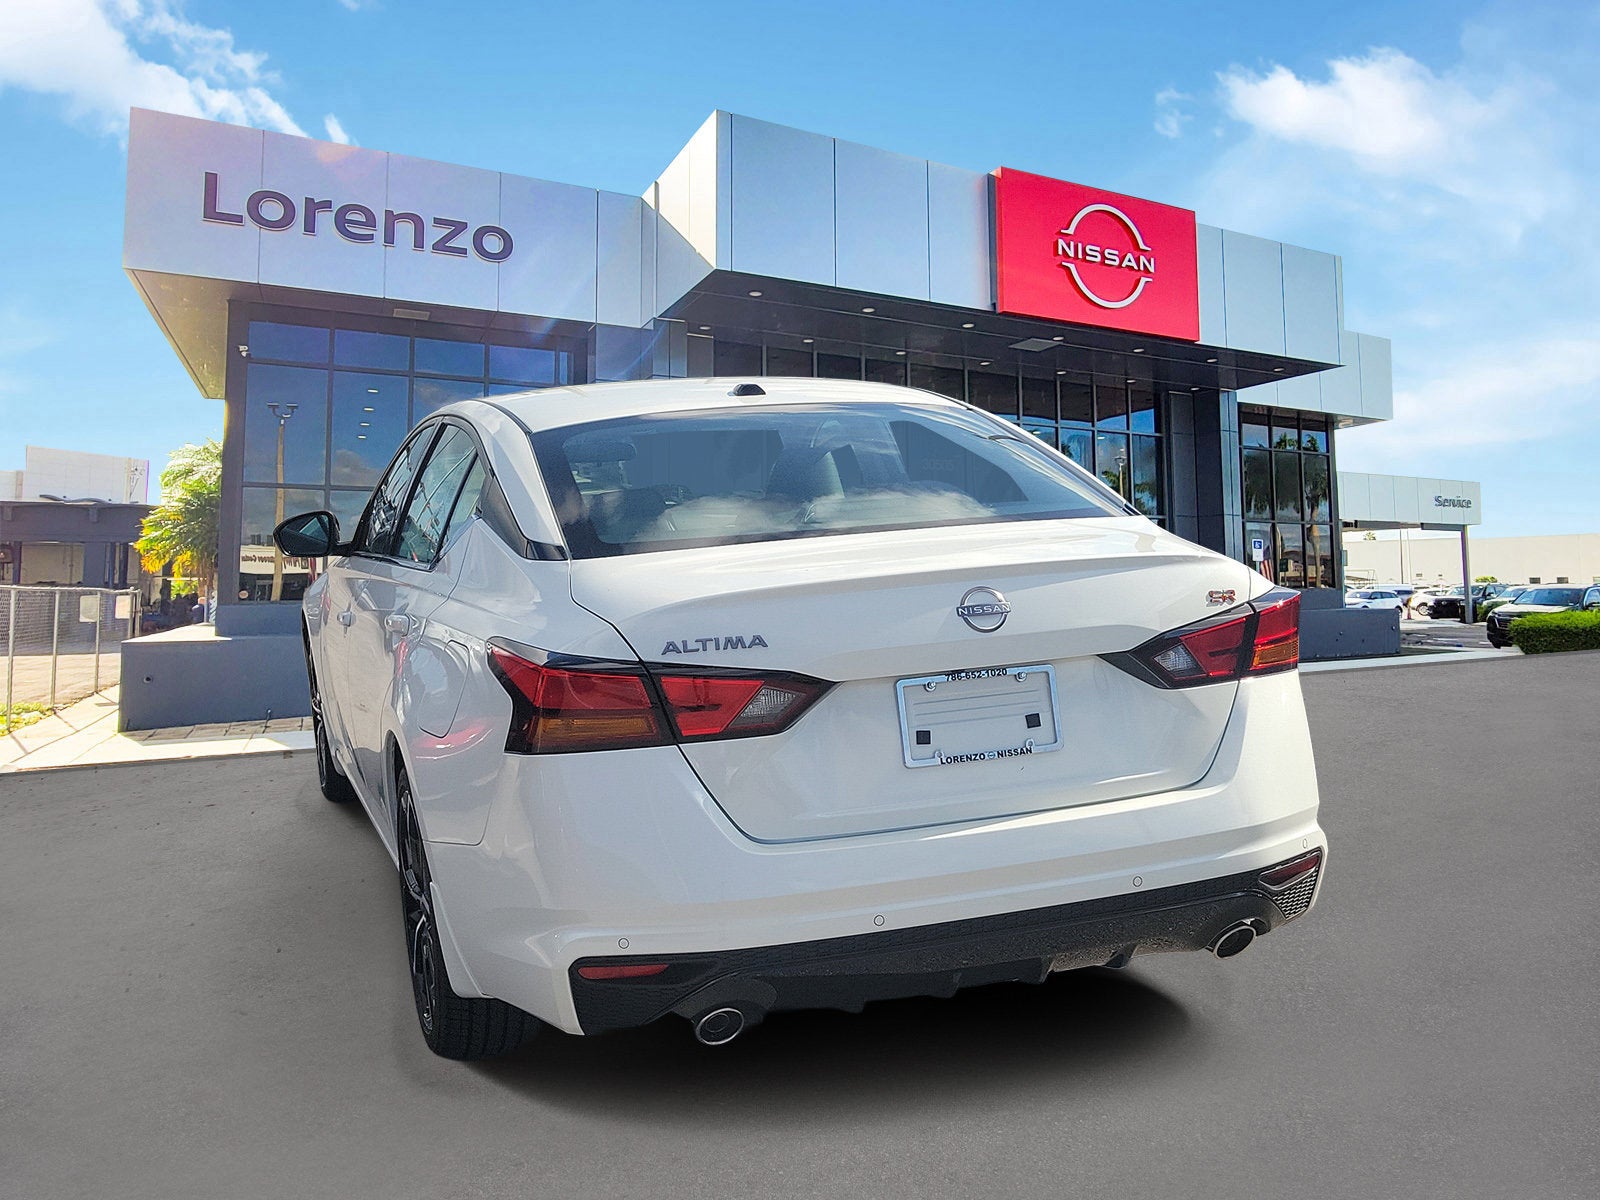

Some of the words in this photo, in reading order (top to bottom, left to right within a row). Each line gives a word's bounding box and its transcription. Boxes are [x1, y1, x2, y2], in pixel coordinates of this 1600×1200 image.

[202, 170, 515, 263] Lorenzo
[1057, 238, 1155, 273] NISSAN
[1434, 495, 1472, 509] Service
[1207, 589, 1237, 604] SR
[958, 603, 1011, 616] NISSAN
[661, 634, 769, 656] ALTIMA
[944, 668, 1008, 682] 786-652-1020
[940, 752, 986, 765] LORENZO
[996, 746, 1033, 759] NISSAN
